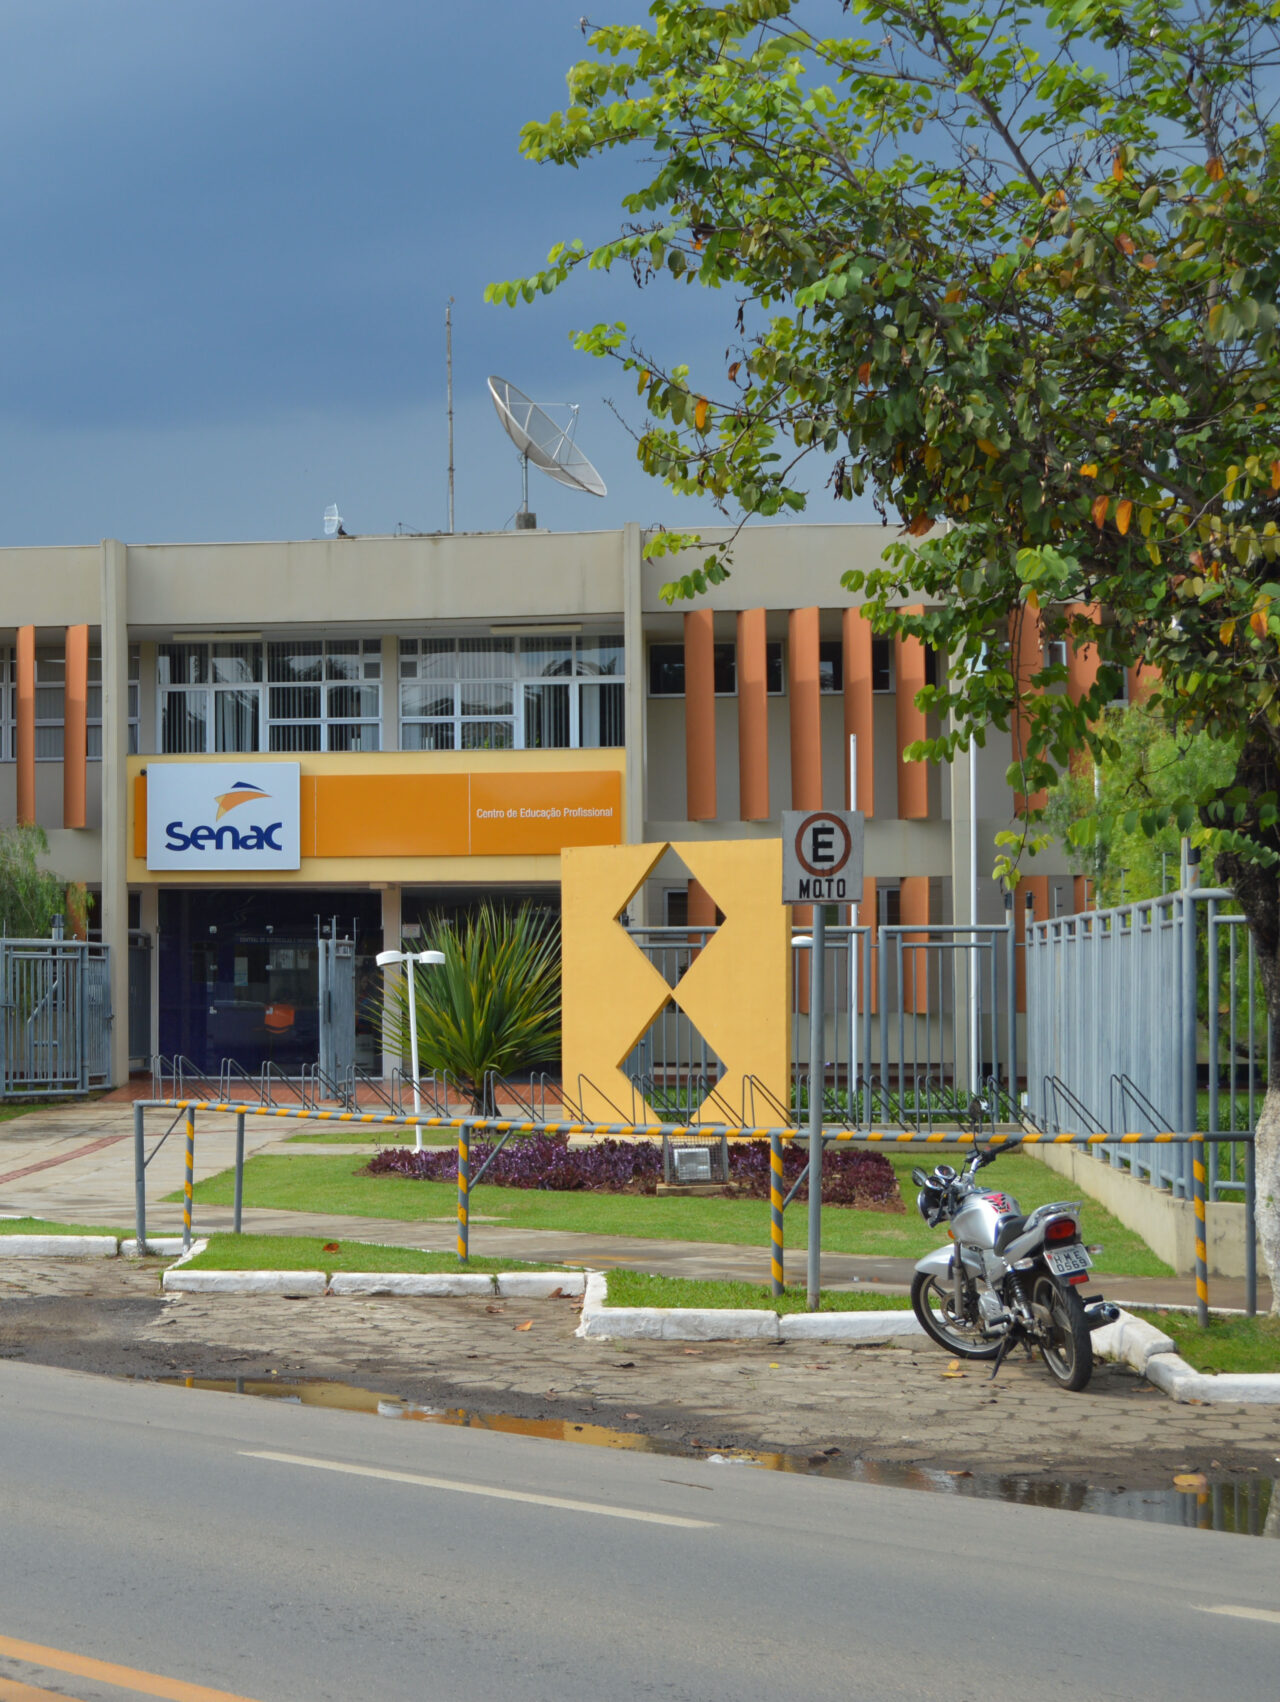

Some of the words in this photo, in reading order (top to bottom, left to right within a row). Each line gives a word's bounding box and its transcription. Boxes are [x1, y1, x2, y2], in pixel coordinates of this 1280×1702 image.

[476, 808, 505, 818] Centro
[507, 808, 518, 818] de
[520, 807, 562, 819] Educação
[563, 807, 613, 817] Profissional
[165, 821, 283, 851] Senac
[812, 827, 835, 862] E
[799, 878, 846, 899] MOTO
[1056, 1259, 1087, 1272] 0569
